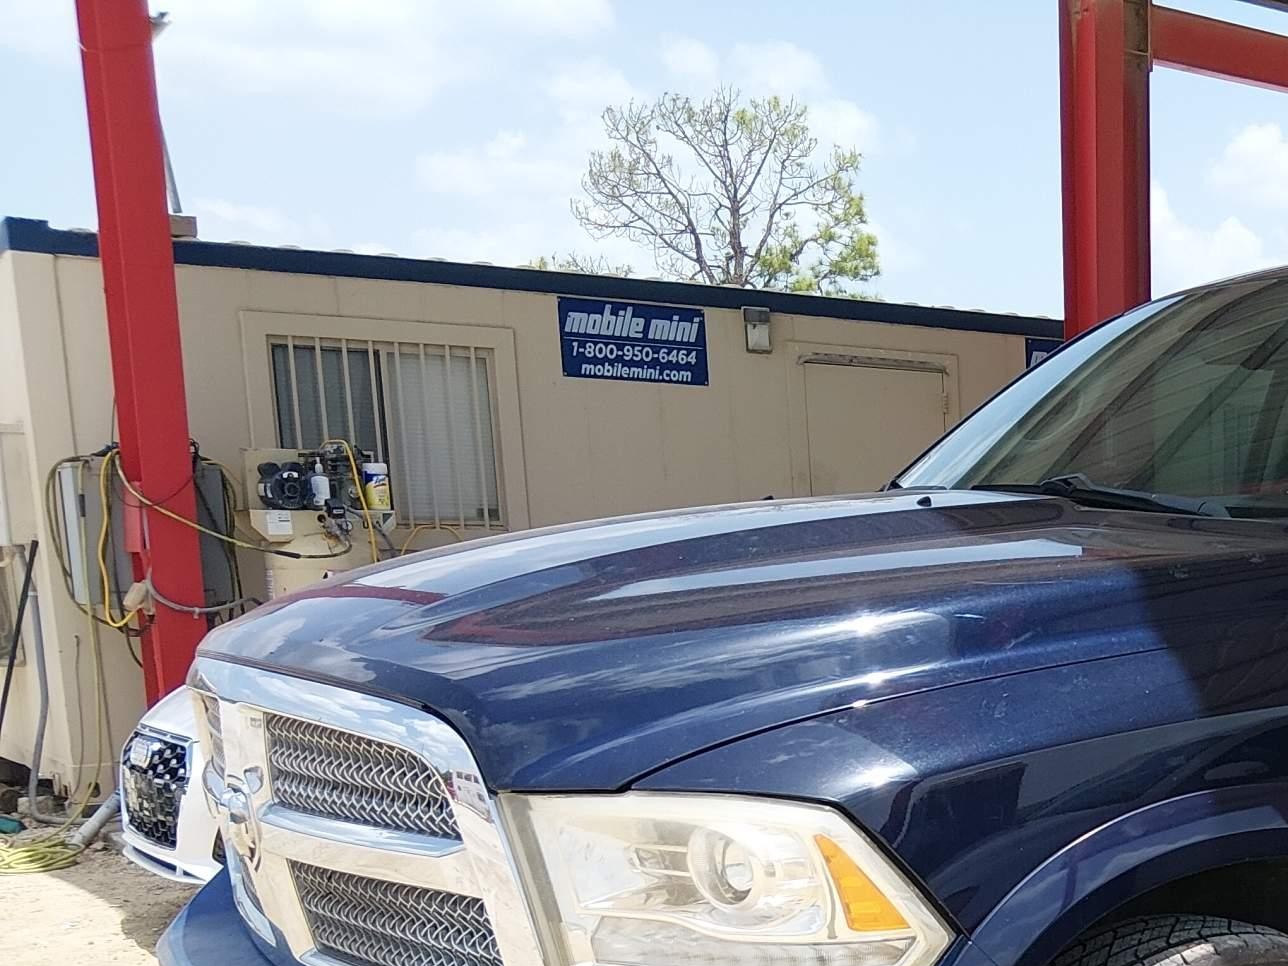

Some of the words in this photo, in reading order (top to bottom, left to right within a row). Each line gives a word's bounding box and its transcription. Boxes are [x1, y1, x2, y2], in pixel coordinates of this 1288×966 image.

[565, 304, 645, 338] mobile
[648, 315, 700, 342] mini
[572, 341, 697, 365] 1-800-950-6464
[581, 362, 692, 382] mobilemini.com
